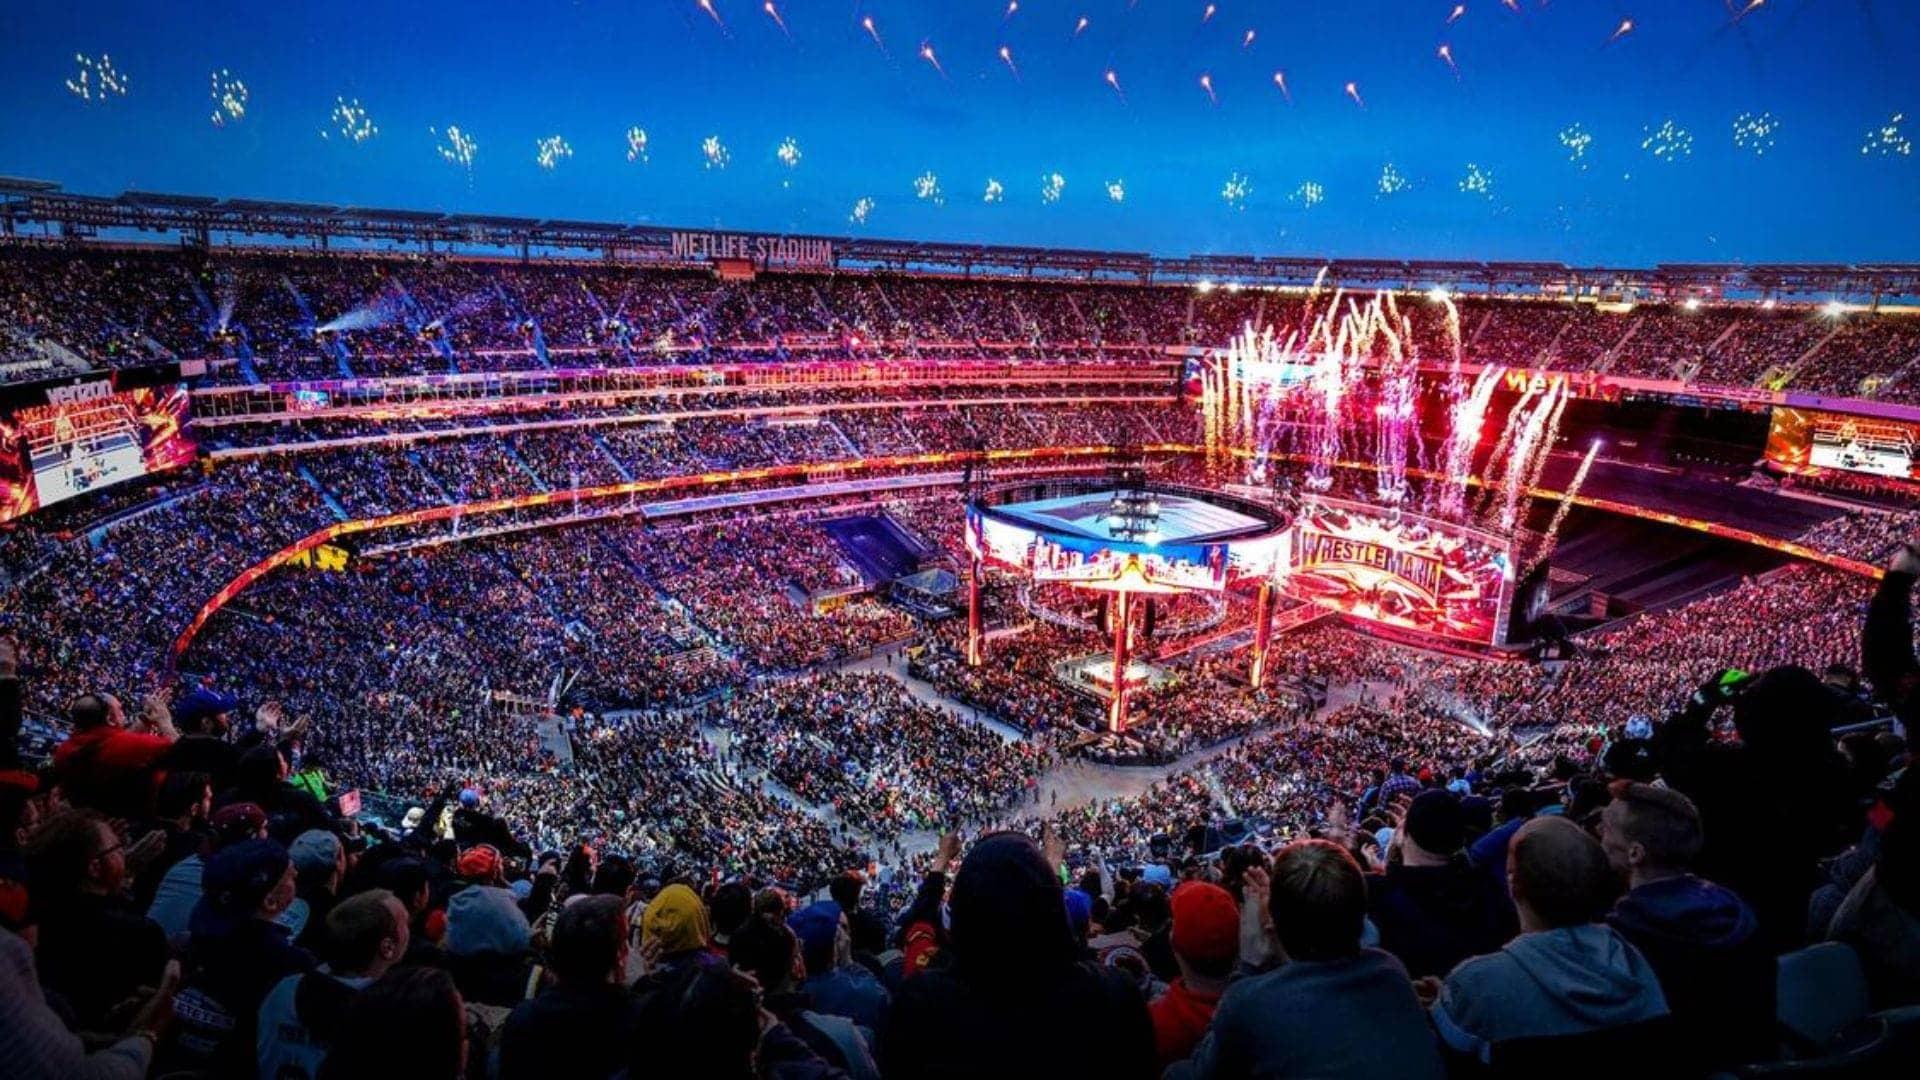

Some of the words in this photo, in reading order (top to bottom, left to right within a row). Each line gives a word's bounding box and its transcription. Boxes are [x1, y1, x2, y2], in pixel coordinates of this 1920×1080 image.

[672, 232, 749, 258] METLIFE
[756, 237, 832, 262] STADIUM
[46, 378, 113, 404] verizon
